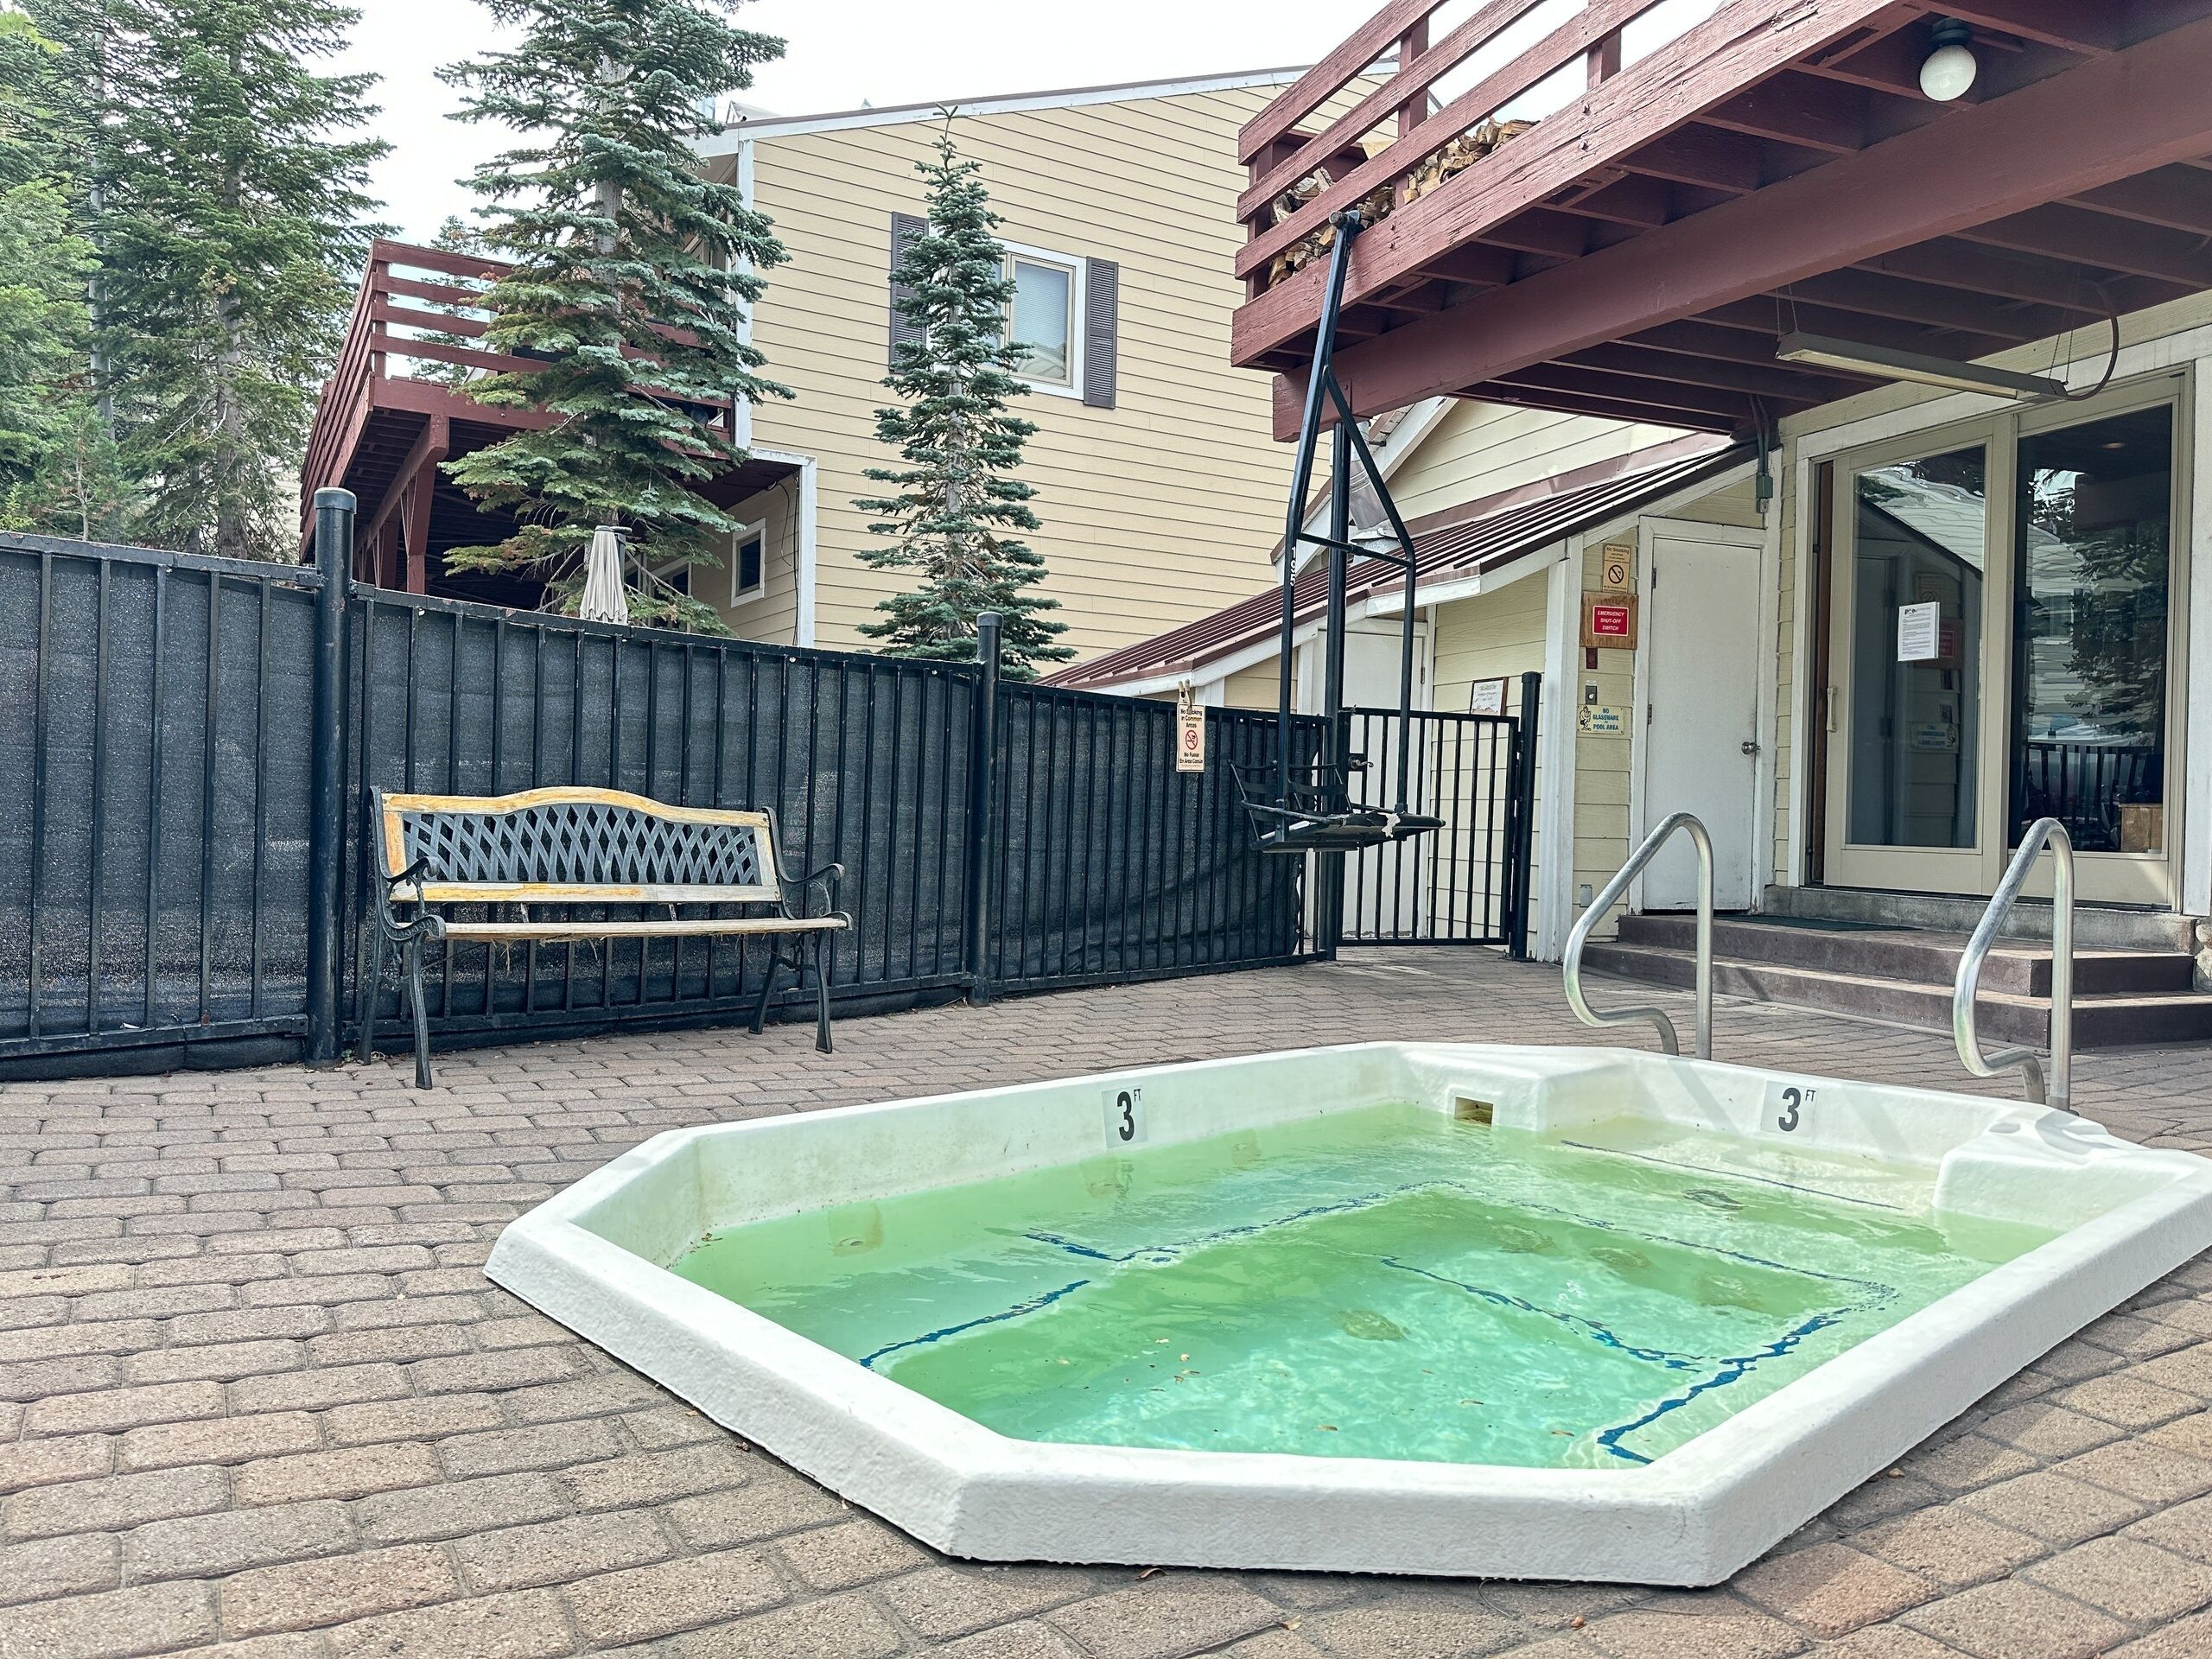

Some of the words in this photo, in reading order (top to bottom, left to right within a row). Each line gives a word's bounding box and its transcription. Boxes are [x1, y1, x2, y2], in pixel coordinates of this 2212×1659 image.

[1116, 1090, 1135, 1141] 3
[1133, 1088, 1141, 1103] FT
[1778, 1087, 1802, 1132] 3
[1805, 1089, 1816, 1102] FT
